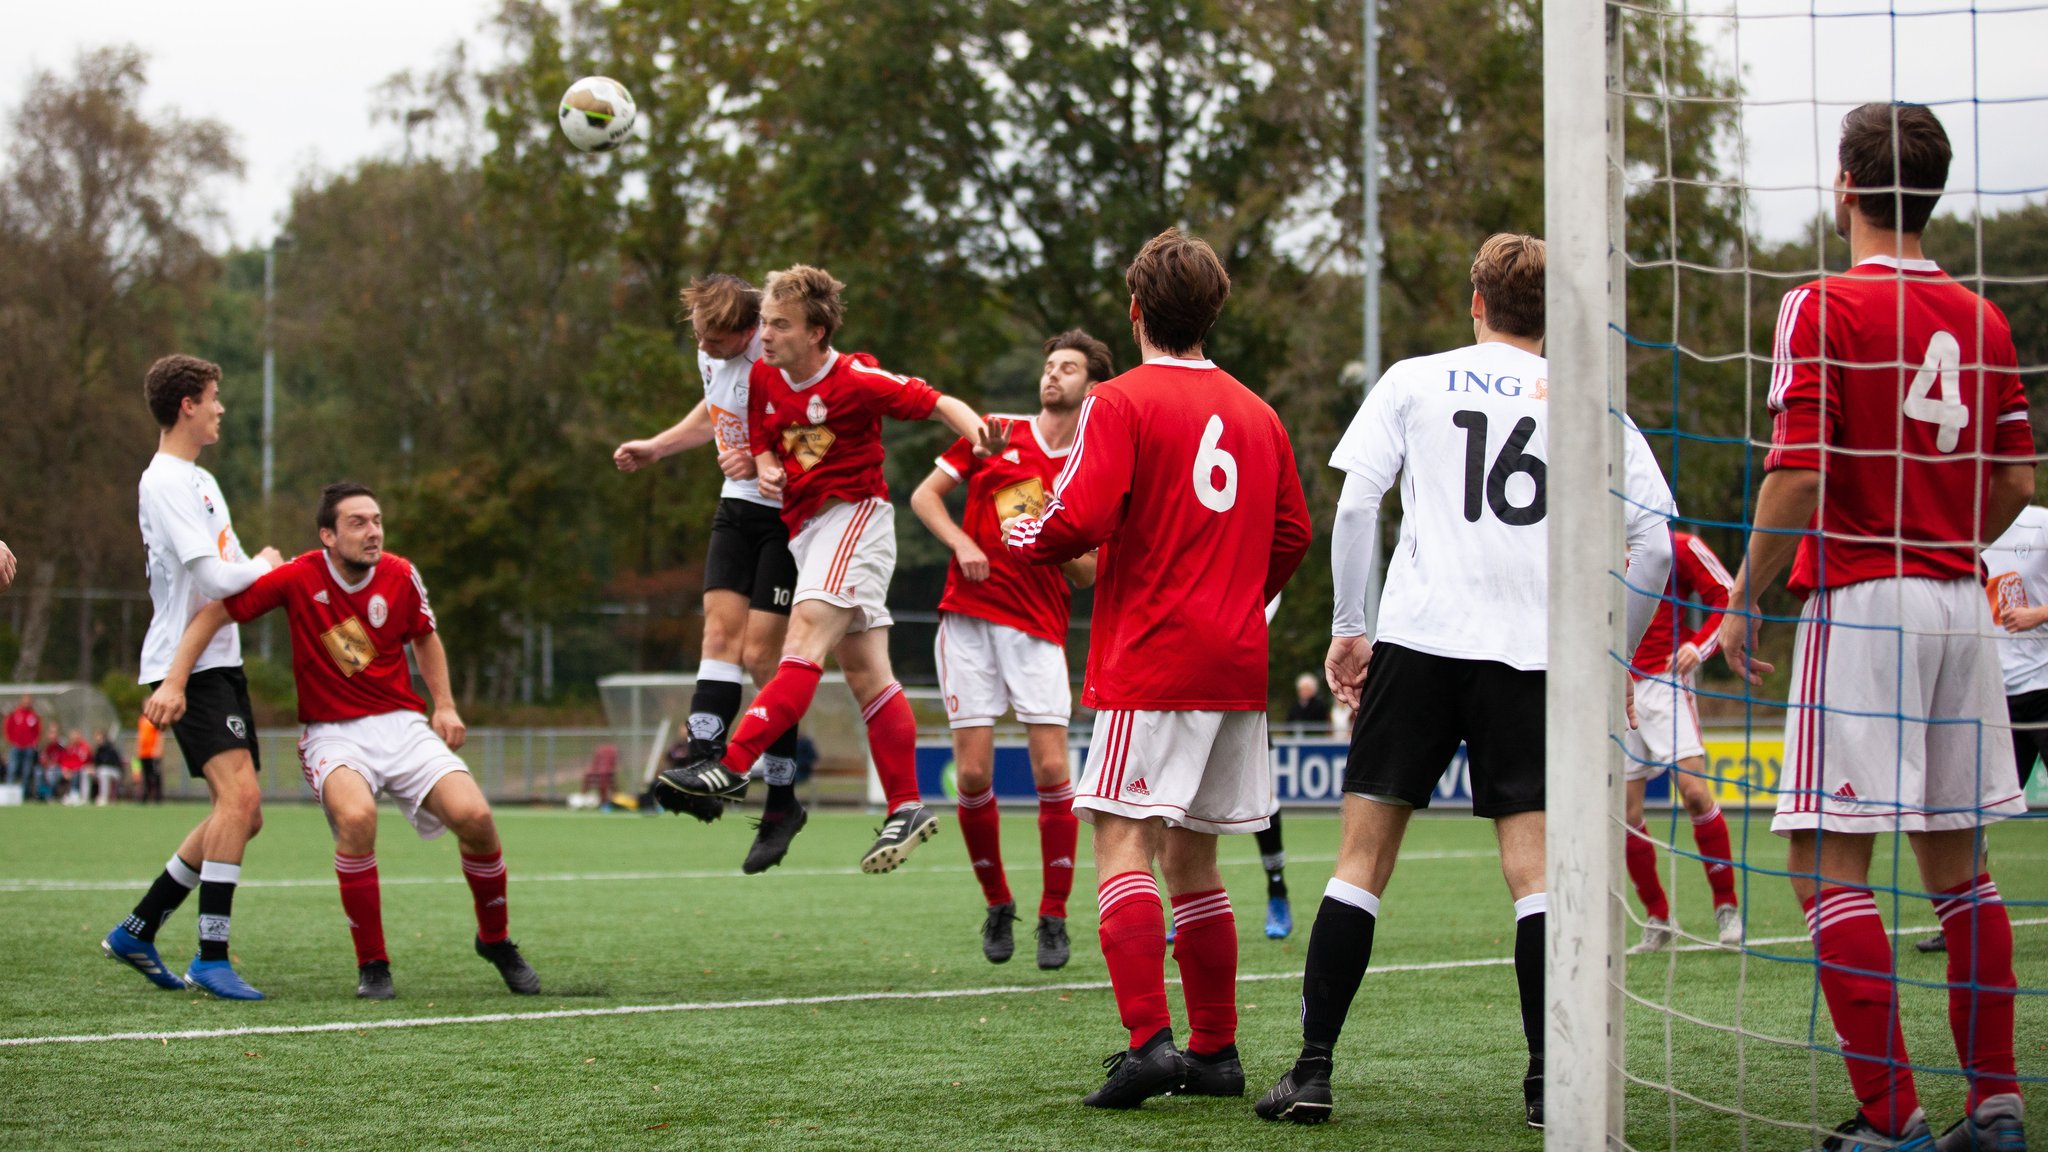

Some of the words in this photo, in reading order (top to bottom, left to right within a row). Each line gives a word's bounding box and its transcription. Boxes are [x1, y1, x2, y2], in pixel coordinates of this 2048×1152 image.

[1446, 370, 1523, 397] ING
[1903, 330, 1969, 453] 4
[1193, 414, 1238, 513] 6
[1453, 410, 1548, 526] 16
[773, 587, 791, 607] 10
[1126, 786, 1150, 796] adidas
